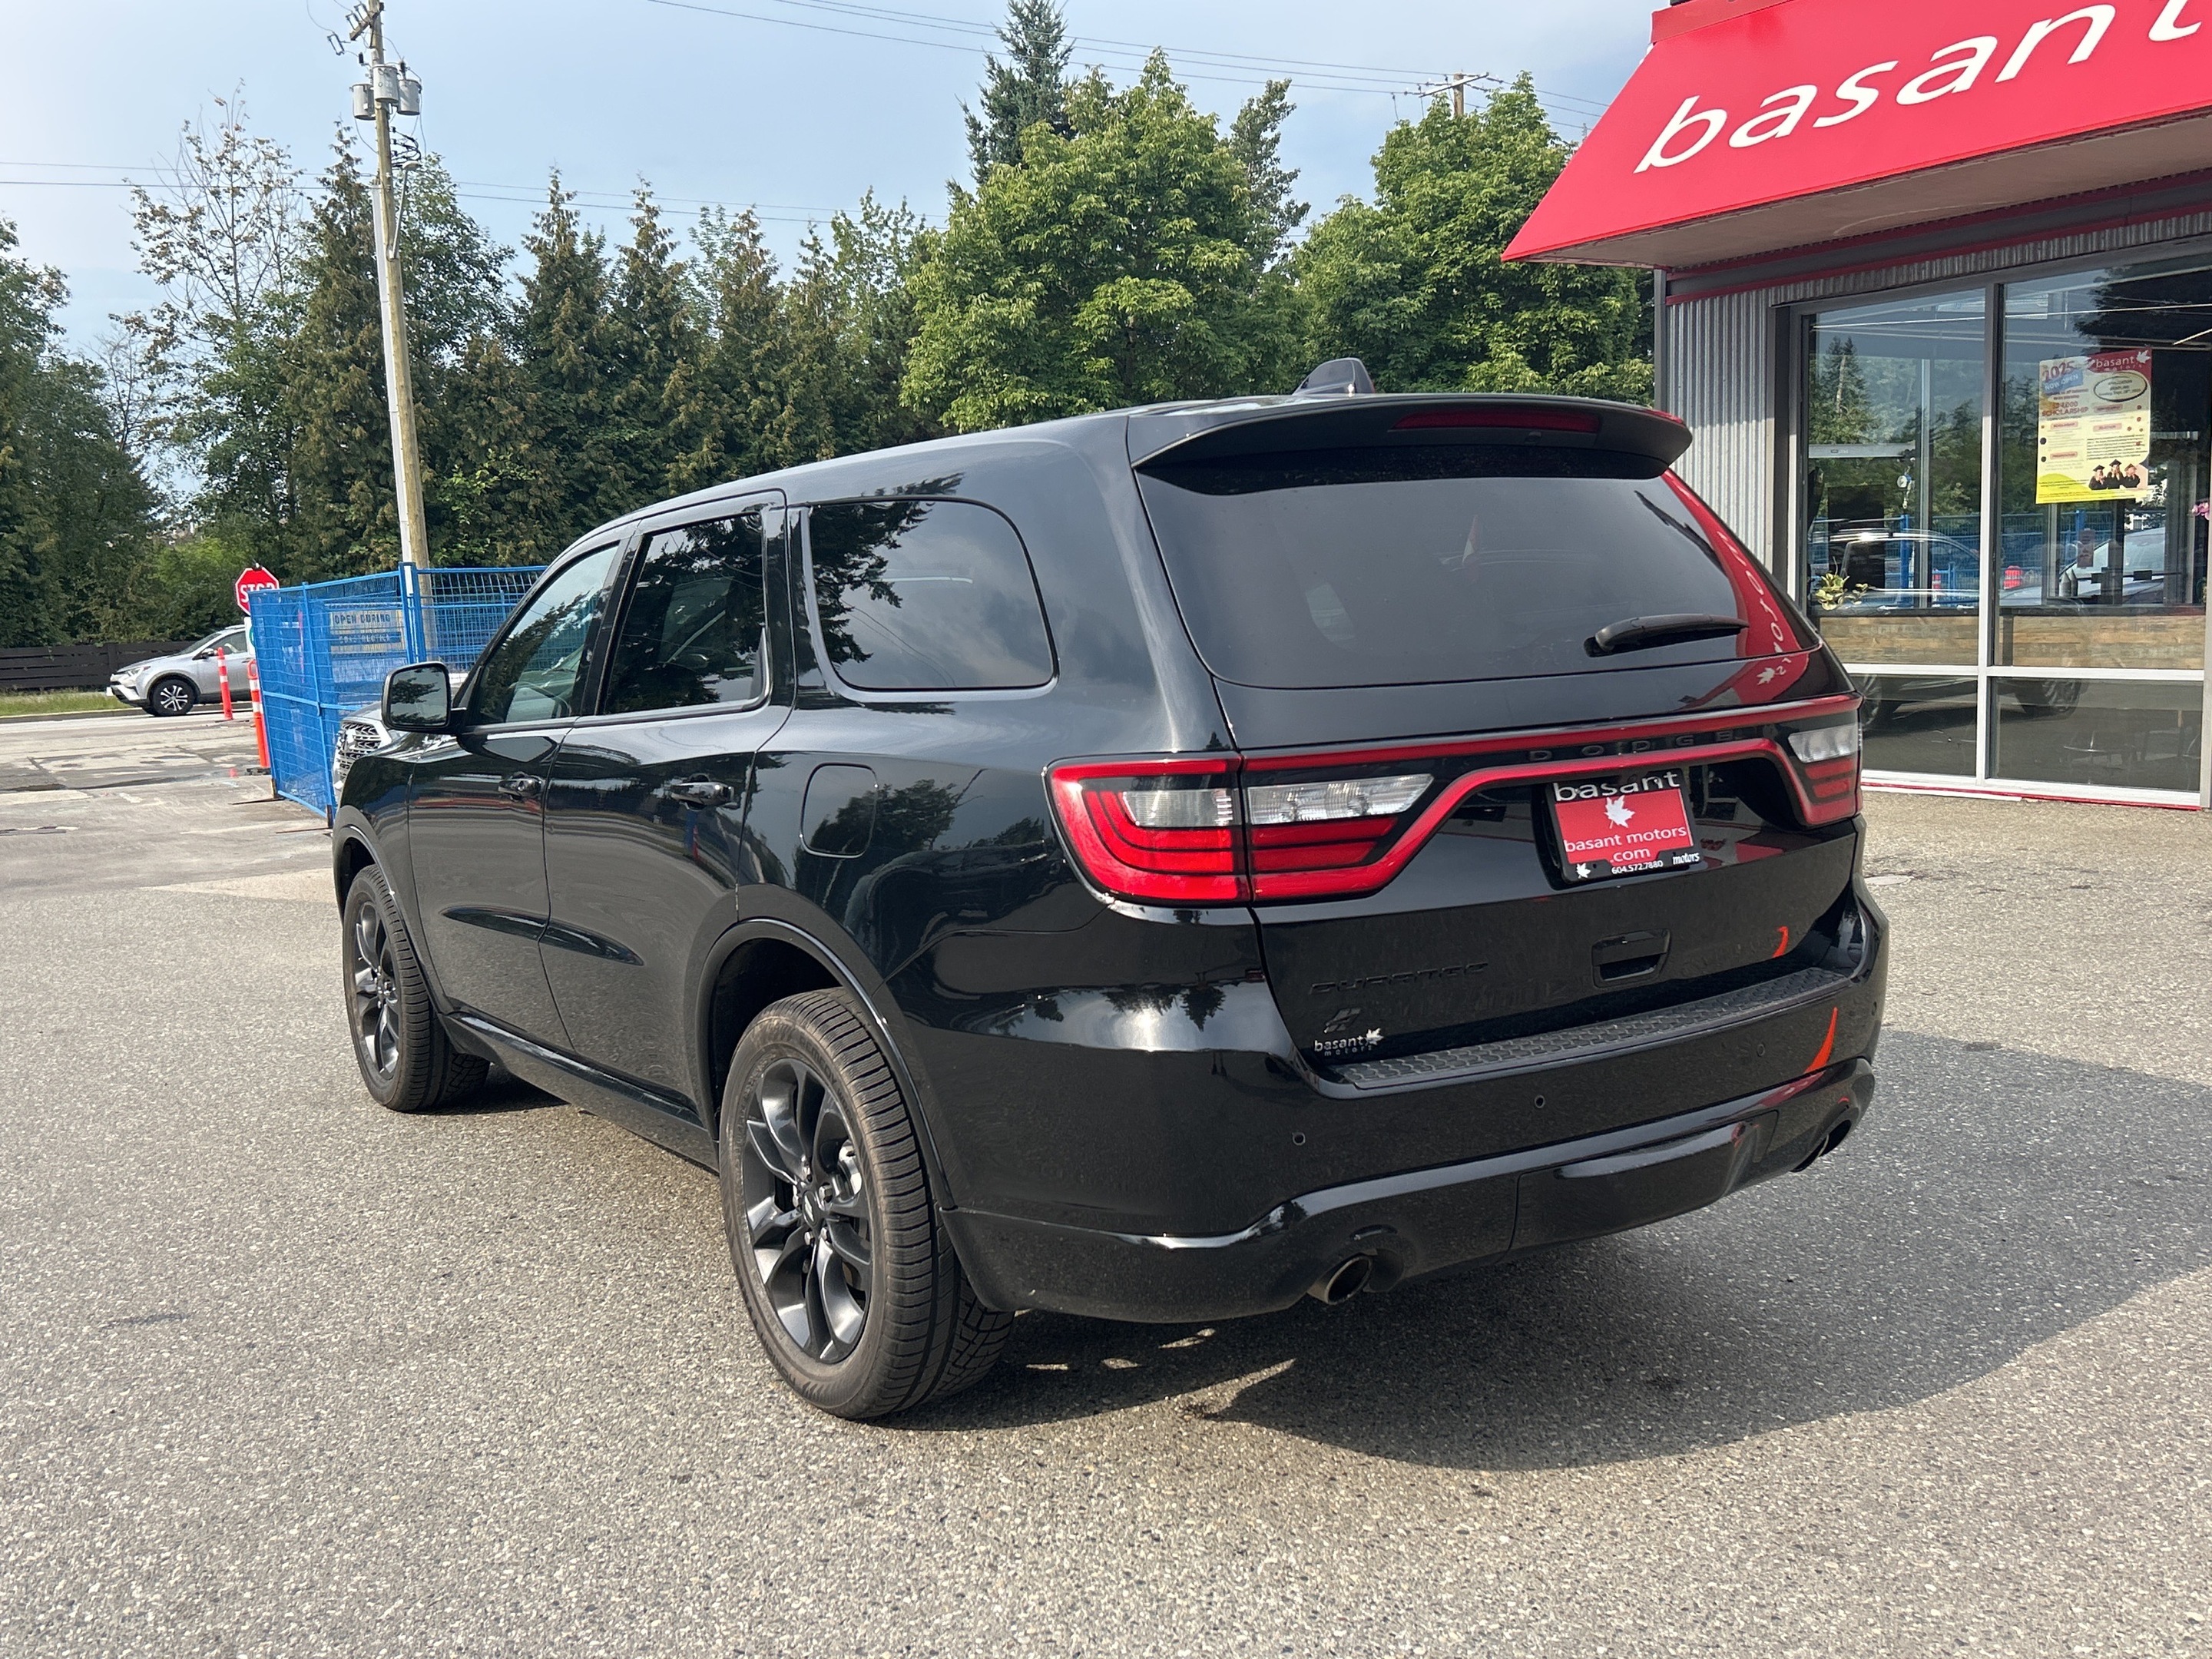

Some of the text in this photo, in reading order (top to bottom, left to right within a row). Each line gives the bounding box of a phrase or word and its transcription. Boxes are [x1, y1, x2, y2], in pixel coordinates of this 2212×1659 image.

[2096, 356, 2134, 368] basant
[2042, 361, 2076, 382] 2025
[2045, 374, 2078, 391] NOW OPEN
[334, 613, 391, 624] OPEN DURING
[1529, 730, 1734, 761] DODGE
[1553, 772, 1681, 801] basant
[1564, 826, 1687, 853] basant motors
[1610, 848, 1651, 863] .com
[1672, 852, 1700, 866] motors
[1314, 1035, 1366, 1052] basant
[1324, 1045, 1373, 1057] motors
